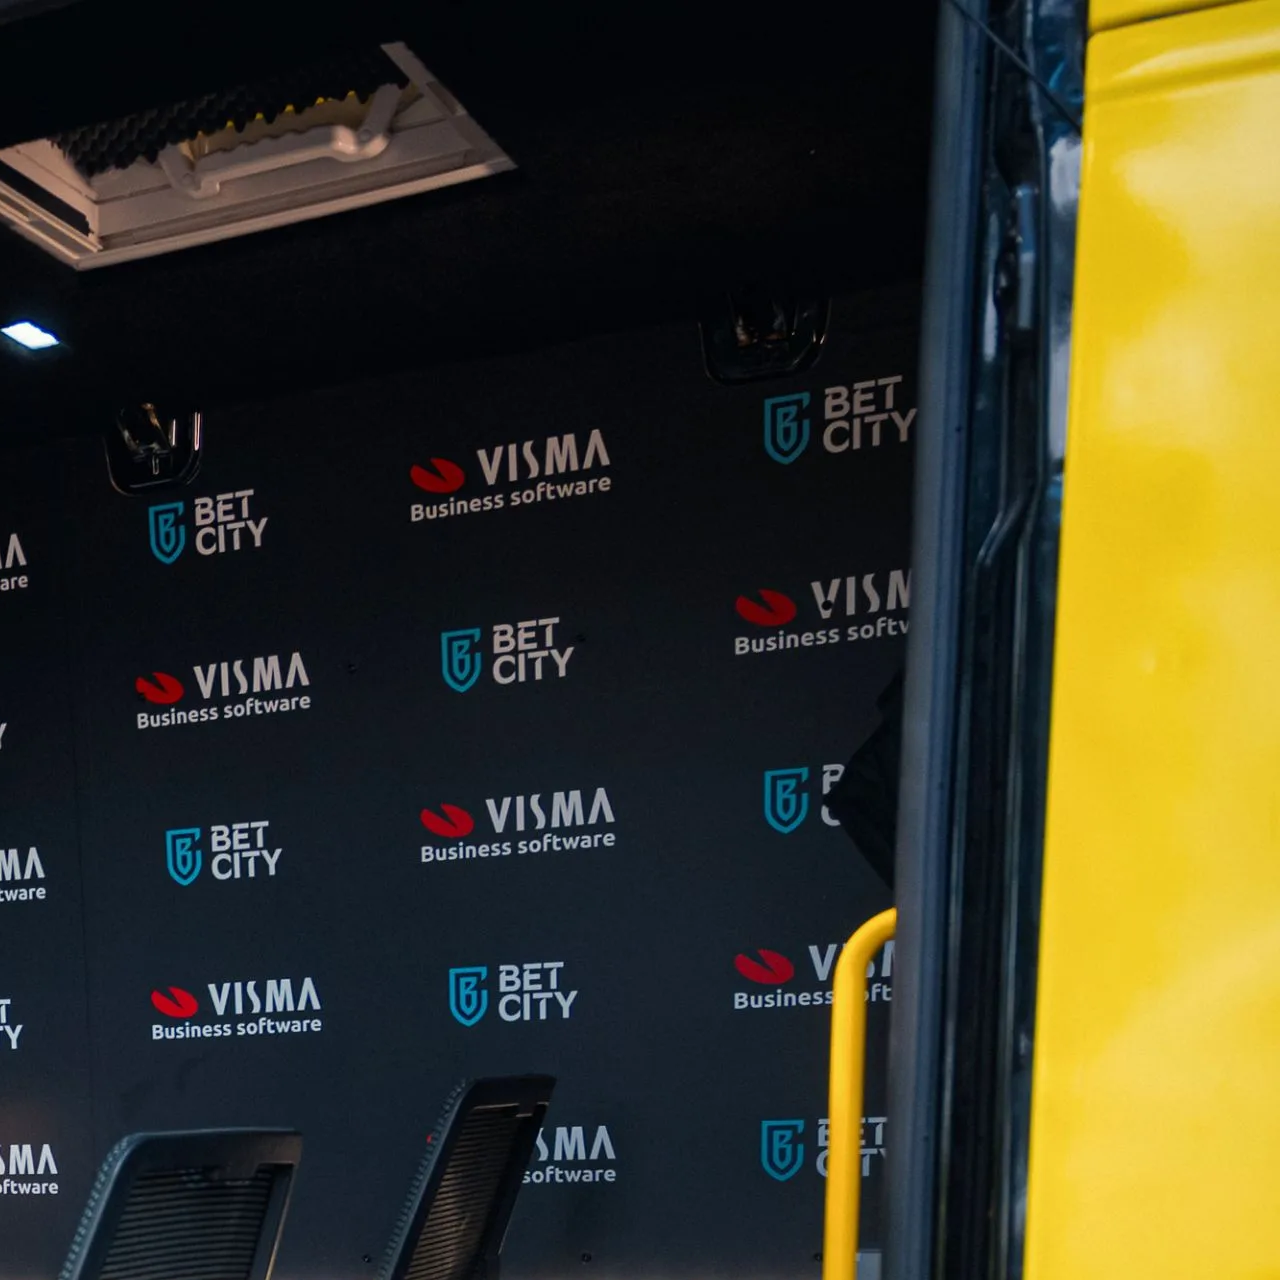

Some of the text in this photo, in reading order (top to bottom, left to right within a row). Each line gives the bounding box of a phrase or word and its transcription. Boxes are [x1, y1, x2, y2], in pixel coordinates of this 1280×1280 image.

[824, 375, 902, 420] BET
[823, 408, 916, 453] CITY
[477, 429, 610, 485] VISMA
[194, 489, 254, 526] BET
[411, 477, 611, 522] Business software
[195, 517, 268, 555] CITY
[811, 570, 910, 619] VISM
[493, 617, 560, 654] BET
[735, 628, 840, 655] Business
[193, 652, 310, 699] VISMA
[493, 647, 574, 684] CITY
[137, 696, 311, 729] Business software
[485, 787, 615, 833] VISMA
[211, 821, 269, 852] BET
[421, 833, 616, 862] Business software
[211, 848, 282, 880] CITY
[499, 961, 564, 992] BET
[208, 977, 321, 1016] VISMA
[498, 990, 578, 1022] CITY
[152, 1017, 322, 1040] Business software
[536, 1125, 616, 1161] SMA
